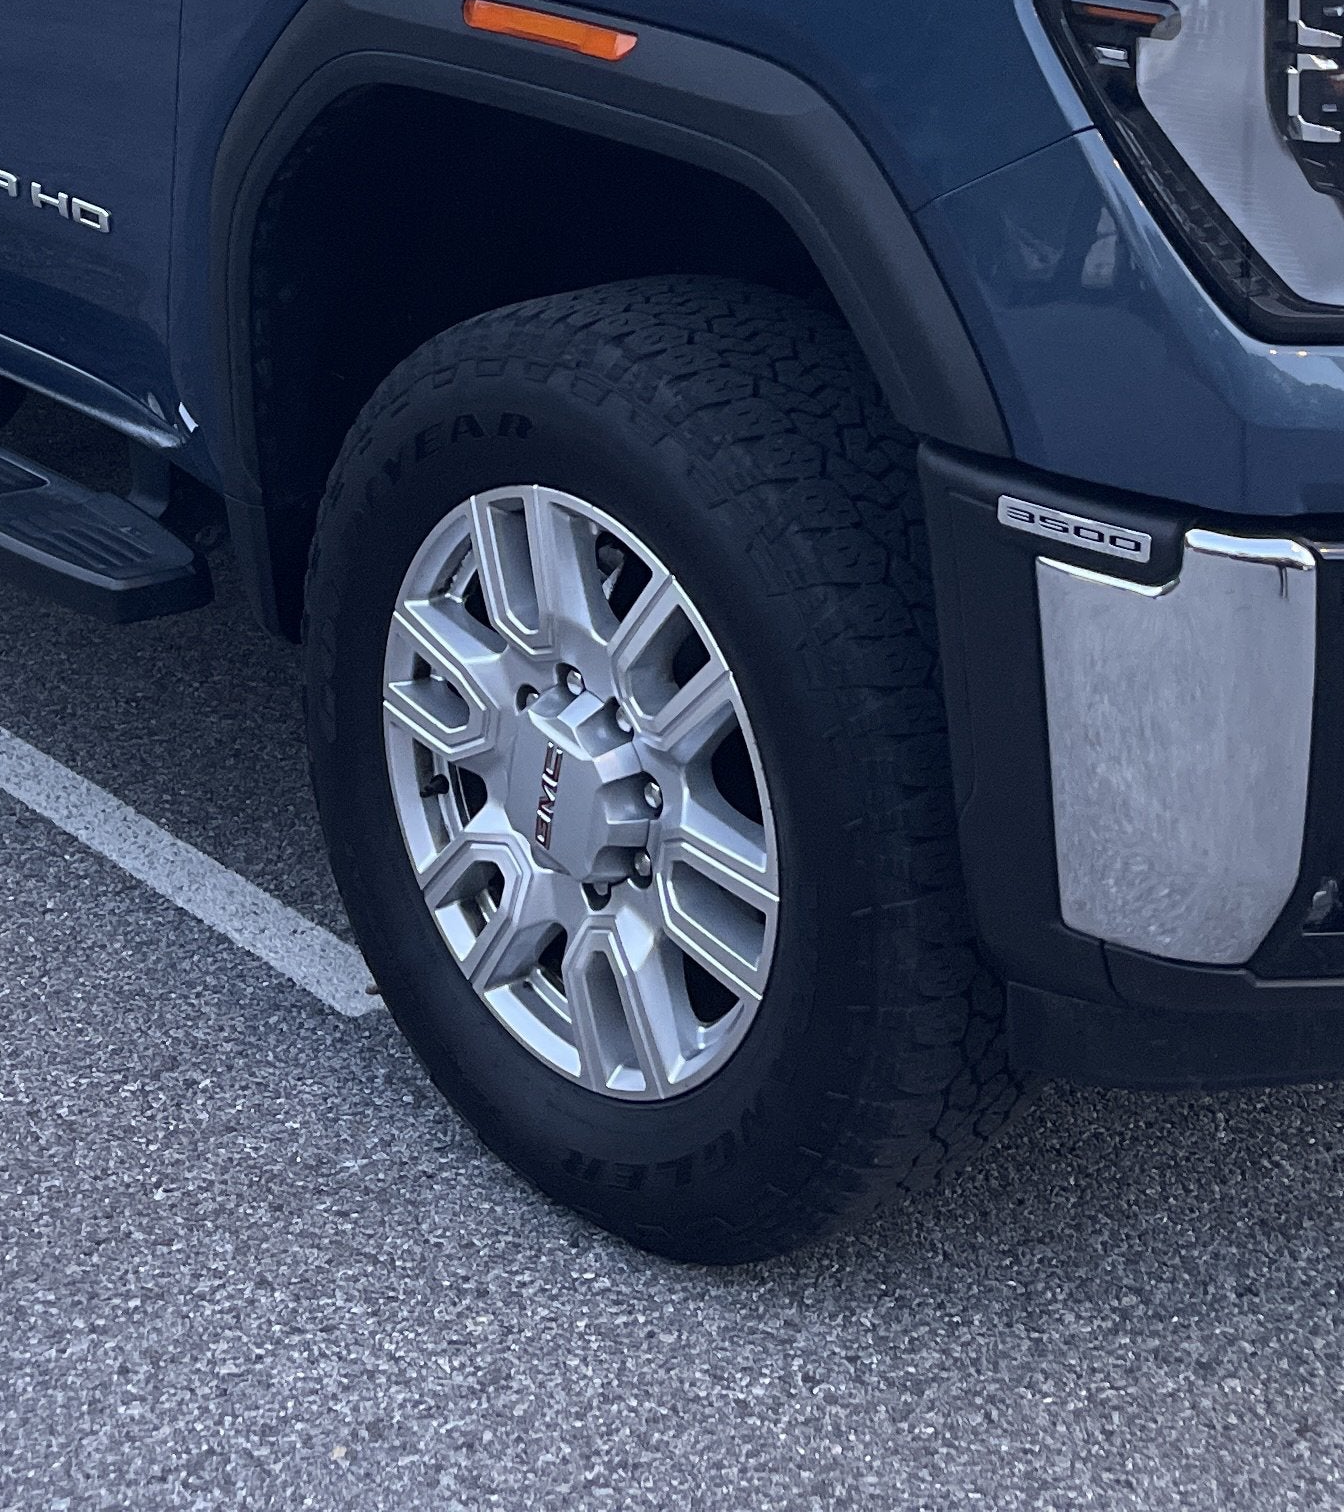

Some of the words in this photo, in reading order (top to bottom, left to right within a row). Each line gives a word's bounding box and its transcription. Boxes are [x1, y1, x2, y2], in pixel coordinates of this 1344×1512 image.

[30, 180, 113, 234] HD
[1006, 505, 1142, 553] 3500
[535, 740, 564, 851] GMC
